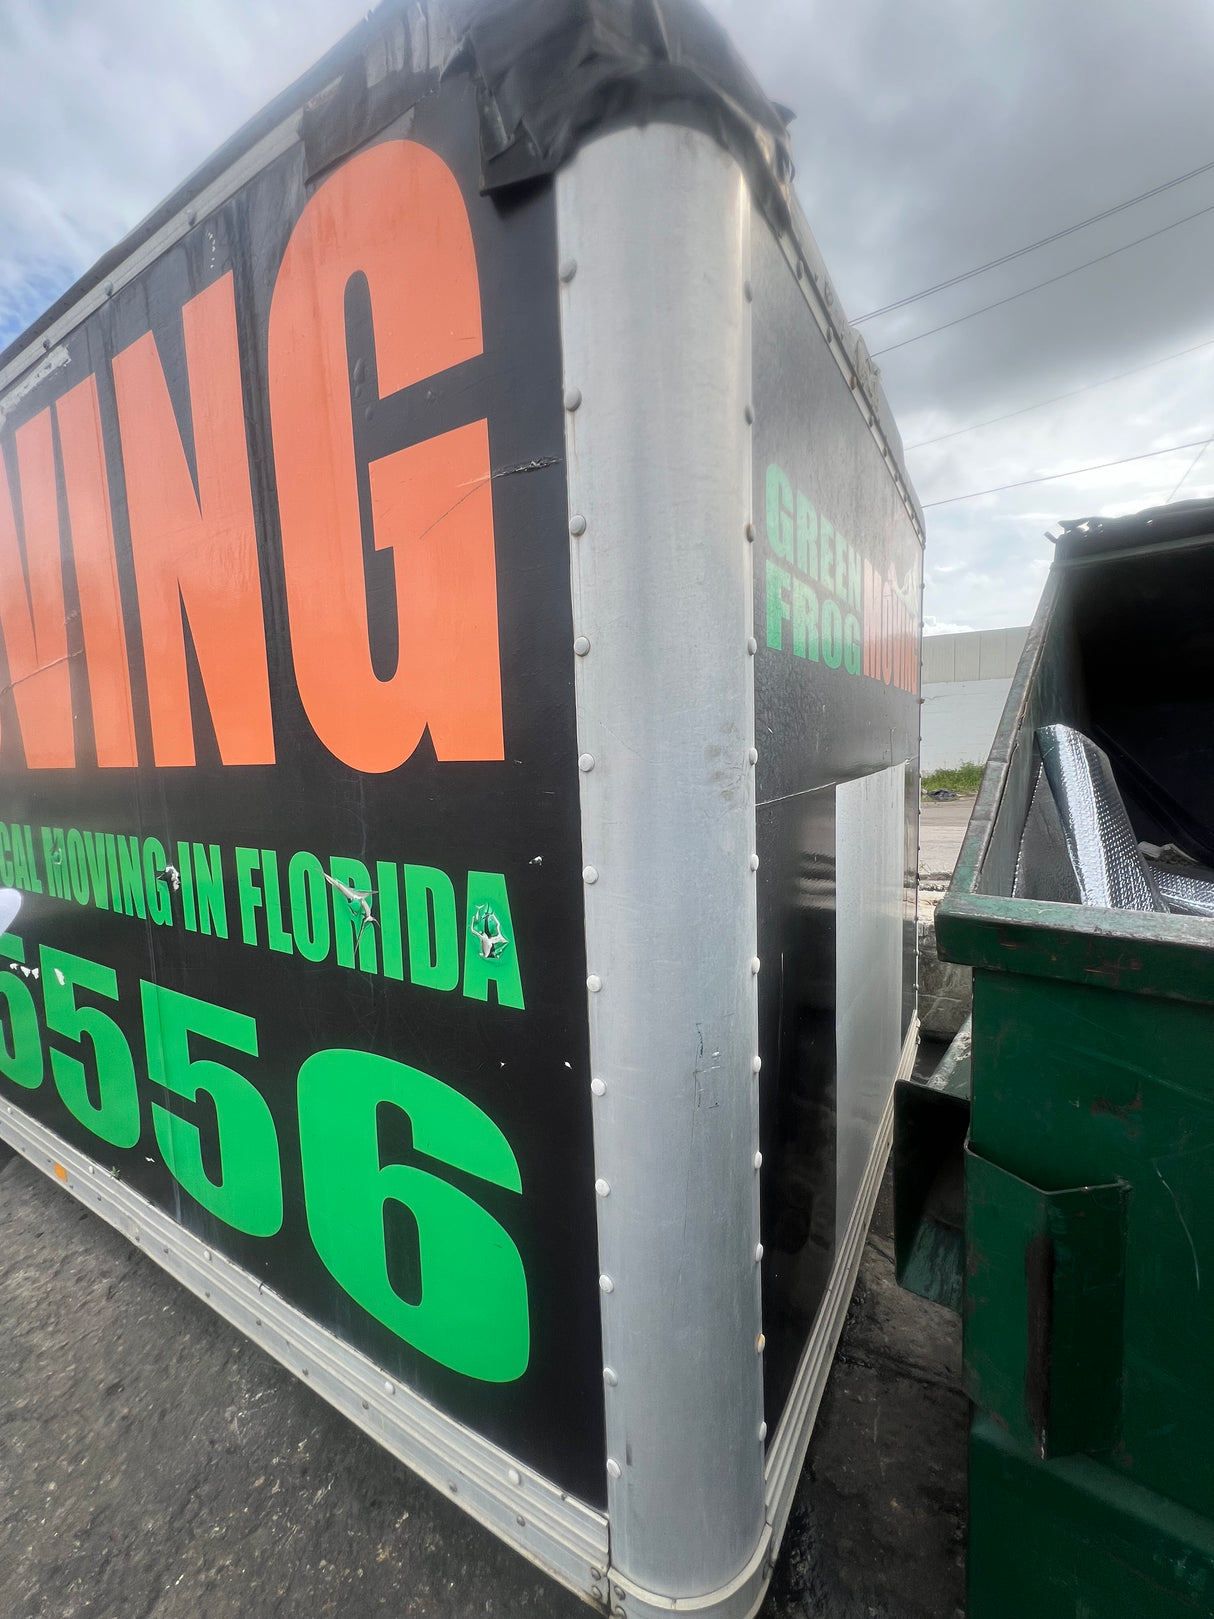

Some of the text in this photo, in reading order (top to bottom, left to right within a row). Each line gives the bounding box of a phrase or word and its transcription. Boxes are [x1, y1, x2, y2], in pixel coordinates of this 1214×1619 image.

[0, 140, 505, 773] VING
[766, 463, 861, 614] GREEN
[766, 558, 861, 677] FROG
[41, 826, 173, 927] MOVING
[177, 840, 229, 940] IN
[235, 846, 526, 1011] FLORIDA
